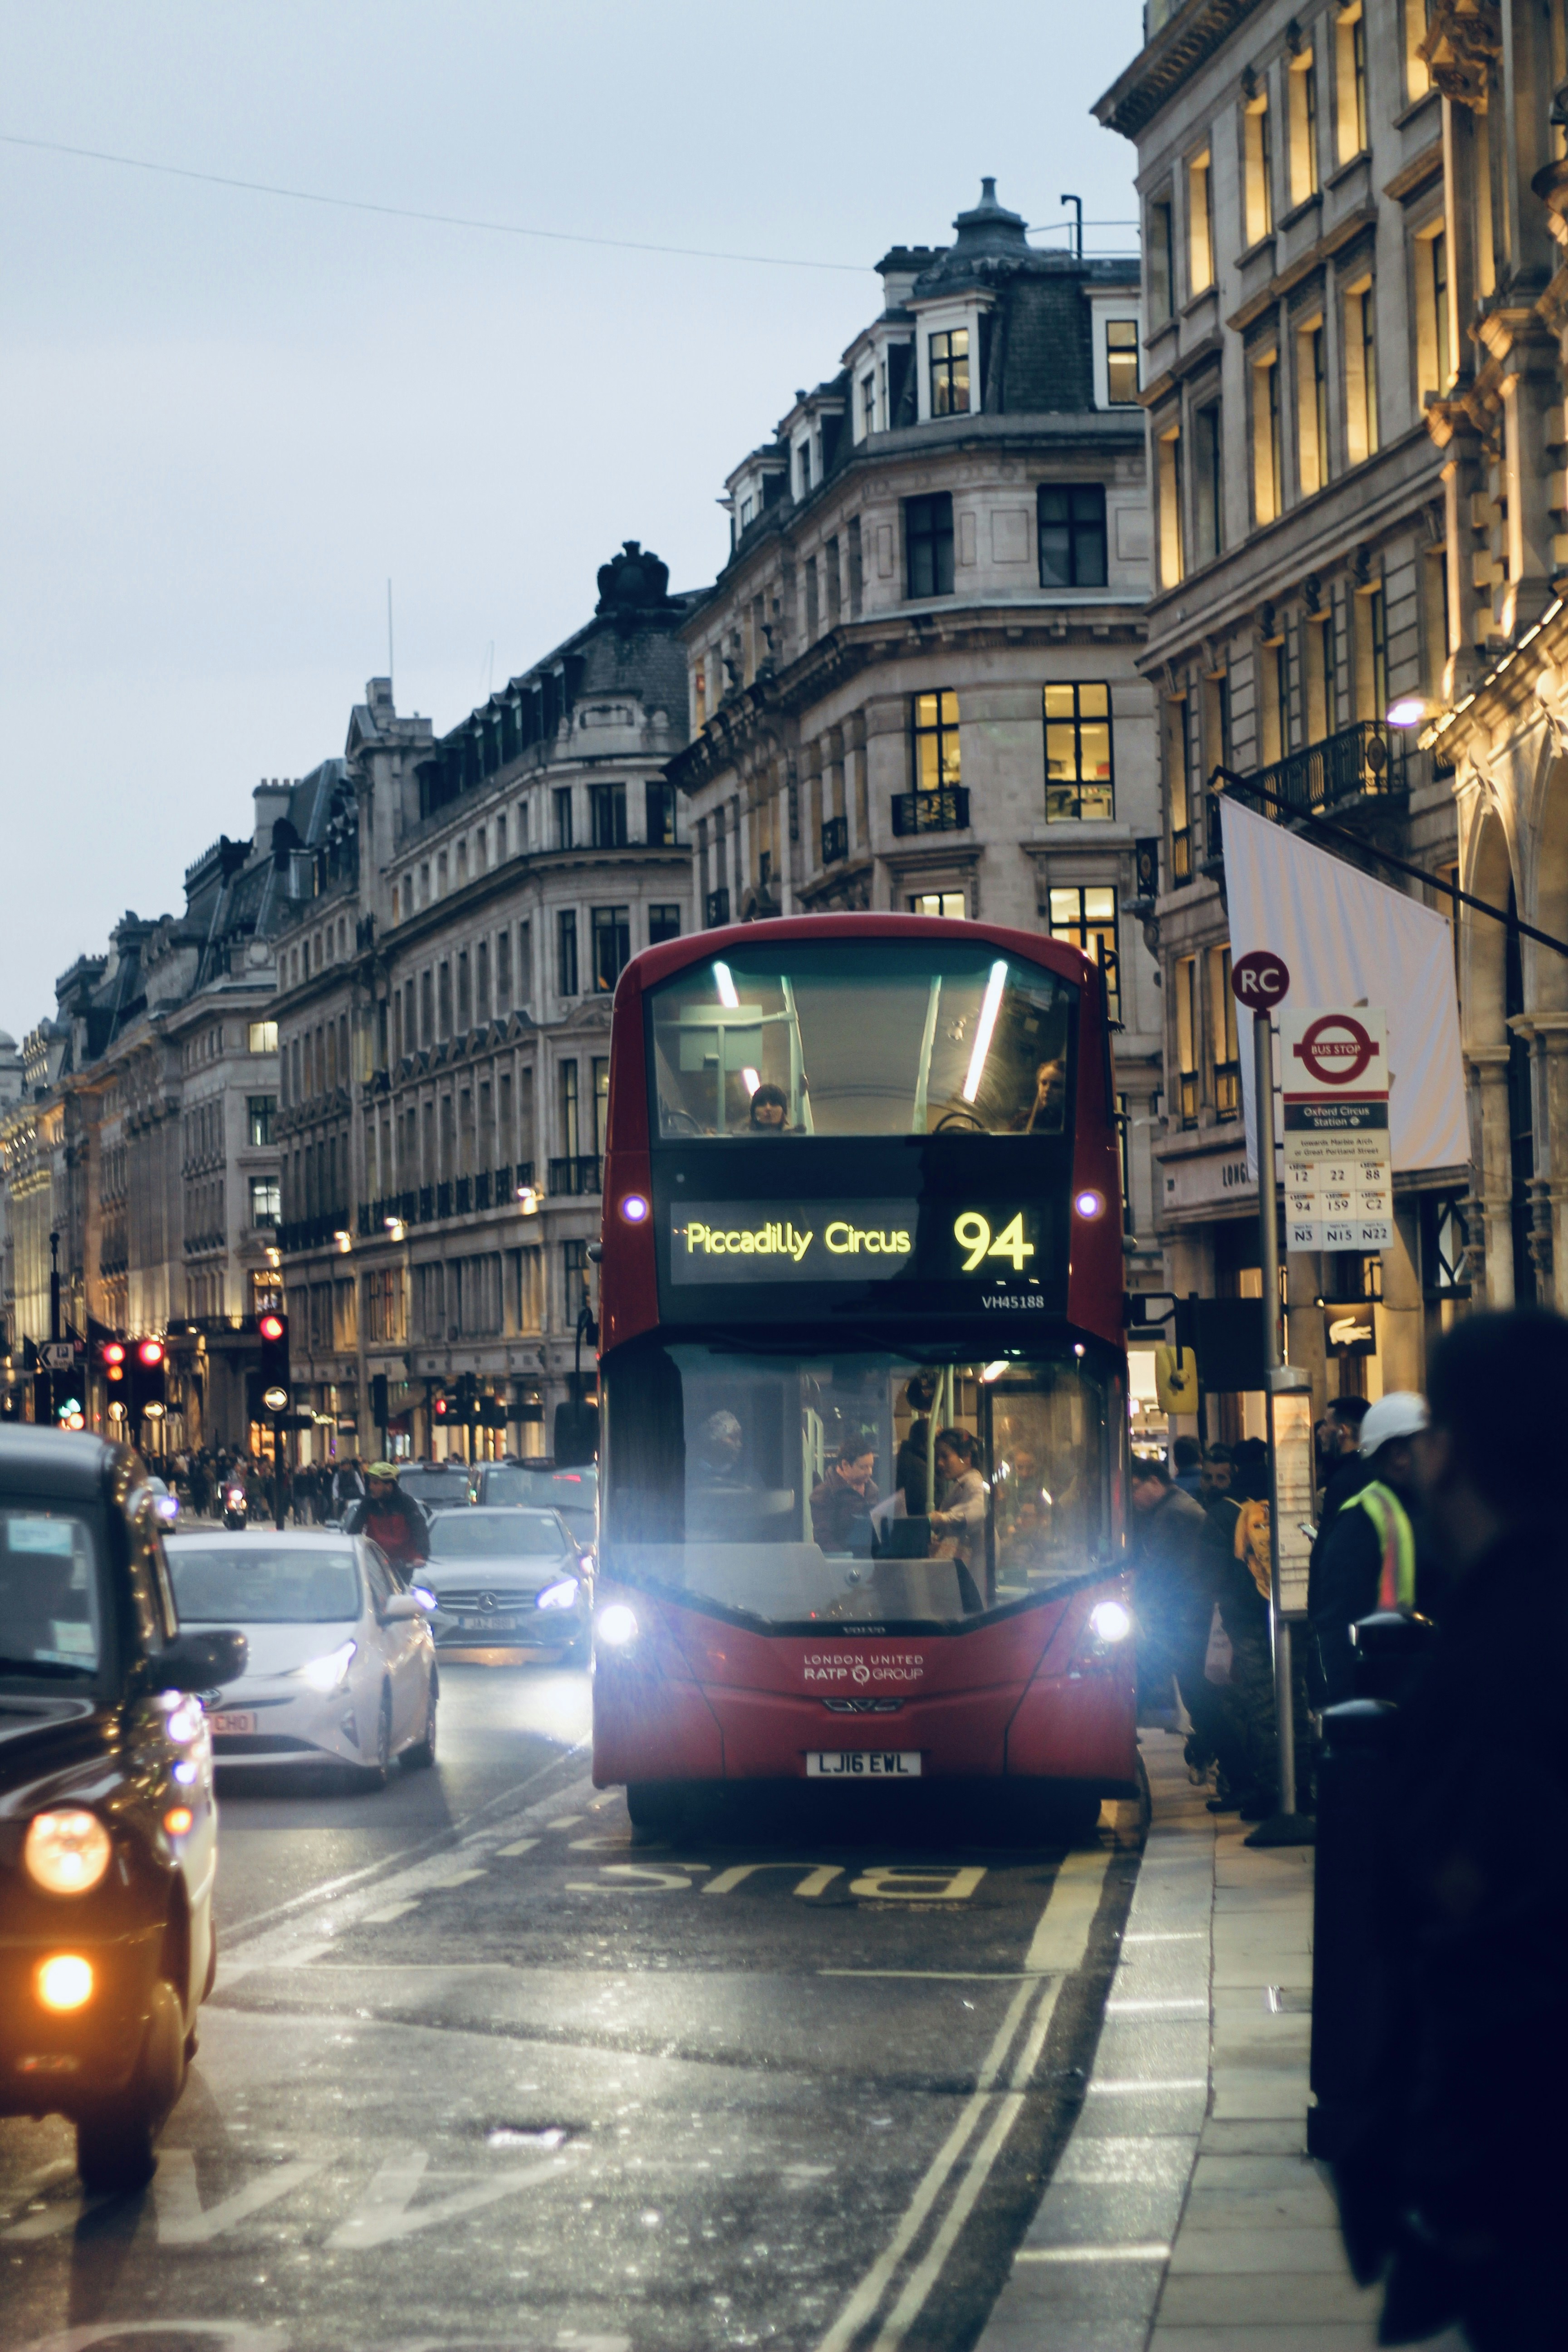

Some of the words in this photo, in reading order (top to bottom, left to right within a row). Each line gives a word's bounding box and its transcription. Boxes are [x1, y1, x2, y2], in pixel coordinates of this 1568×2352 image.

[1241, 968, 1279, 993] RC
[1311, 1044, 1331, 1055] BUS
[1334, 1044, 1361, 1054] STOP
[1304, 1107, 1338, 1117] Oxford
[1340, 1106, 1370, 1116] Circus
[1314, 1118, 1347, 1127] Station
[1295, 1170, 1308, 1182] 12
[1330, 1170, 1345, 1181] 22
[1365, 1169, 1380, 1180] 88
[1295, 1201, 1310, 1212] 94
[1328, 1200, 1348, 1211] 159
[1366, 1199, 1382, 1210] C2
[1294, 1230, 1313, 1242] N3
[1327, 1229, 1352, 1241] N15
[1362, 1228, 1387, 1240] N22
[687, 1222, 813, 1261] Piccadilly
[824, 1222, 911, 1253] Circus
[953, 1211, 1034, 1271] 94
[981, 1295, 1044, 1309] VH45188
[804, 1655, 863, 1665] LONDON
[870, 1655, 924, 1665] UNITED
[804, 1668, 848, 1680] RATP
[872, 1668, 924, 1680] GROUP
[819, 1754, 864, 1774] LJ16
[869, 1754, 909, 1774] EWL
